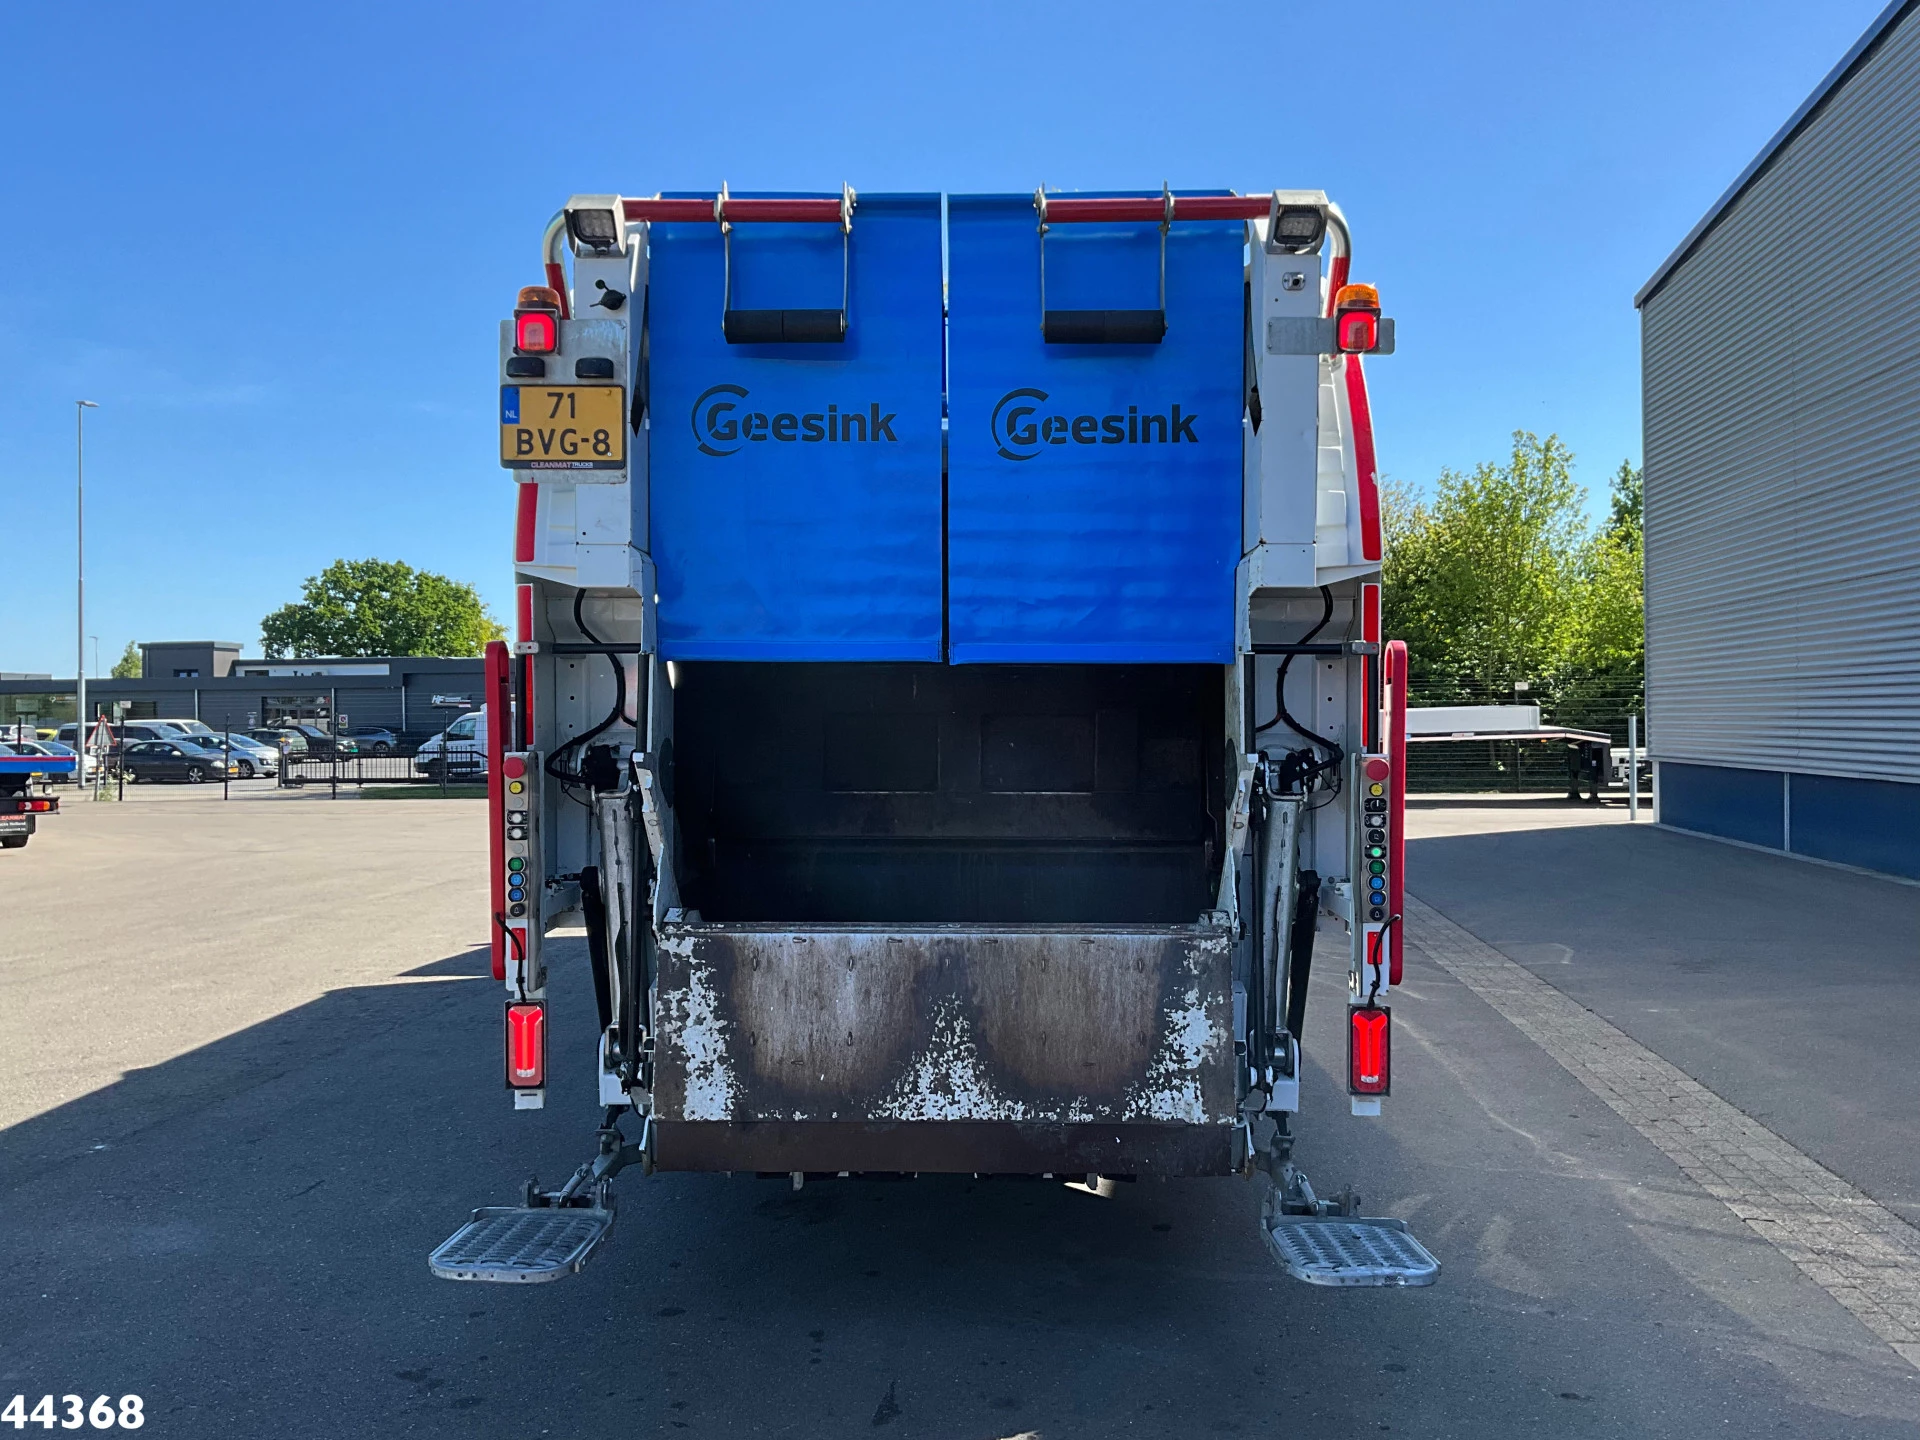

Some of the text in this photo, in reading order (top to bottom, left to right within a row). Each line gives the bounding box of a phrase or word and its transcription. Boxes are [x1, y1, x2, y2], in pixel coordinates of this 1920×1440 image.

[505, 410, 518, 419] NL
[546, 392, 576, 419] 71
[706, 402, 898, 442] Geesink
[1006, 403, 1199, 445] Geesink
[516, 428, 610, 456] BVG-8
